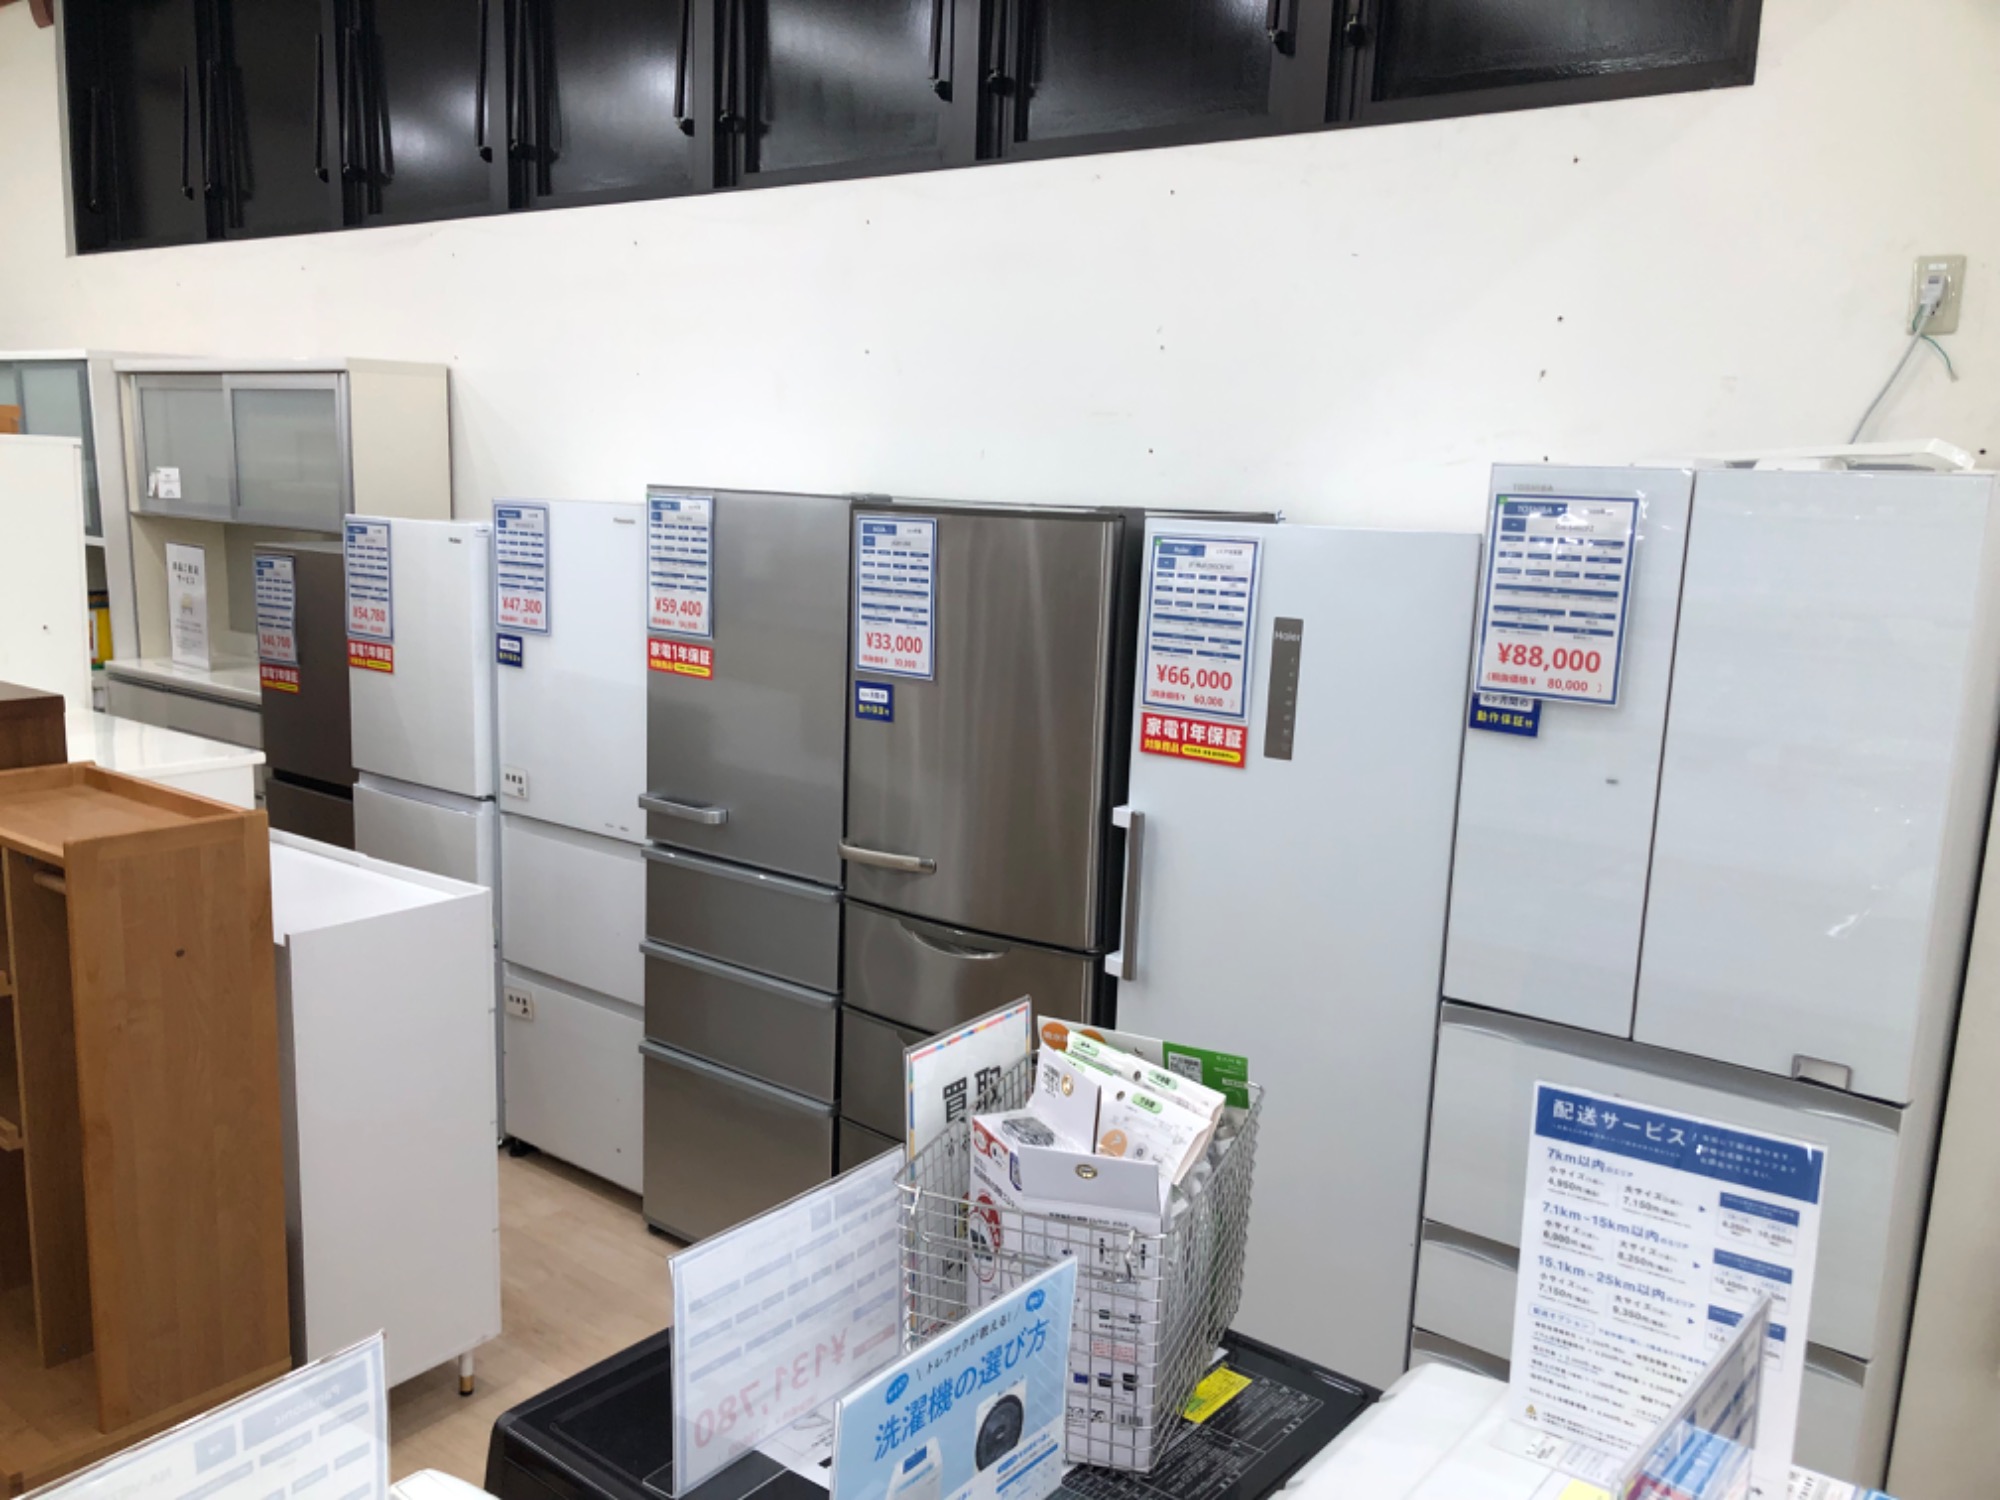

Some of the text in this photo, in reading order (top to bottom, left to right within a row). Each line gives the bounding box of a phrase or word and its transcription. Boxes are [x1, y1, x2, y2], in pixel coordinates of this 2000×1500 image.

[502, 596, 543, 614] ¥47,300
[655, 597, 702, 617] ¥59,400
[865, 632, 923, 653] ¥33,000
[1275, 630, 1301, 642] Haier
[1497, 643, 1602, 673] ¥88,000
[1156, 664, 1233, 691] ¥66,000
[1547, 678, 1588, 691] 80,000
[1145, 717, 1243, 749] 家電1年保証
[1553, 1099, 1686, 1146] 配送サービス
[874, 1318, 1050, 1462] 洗濯機の選び方
